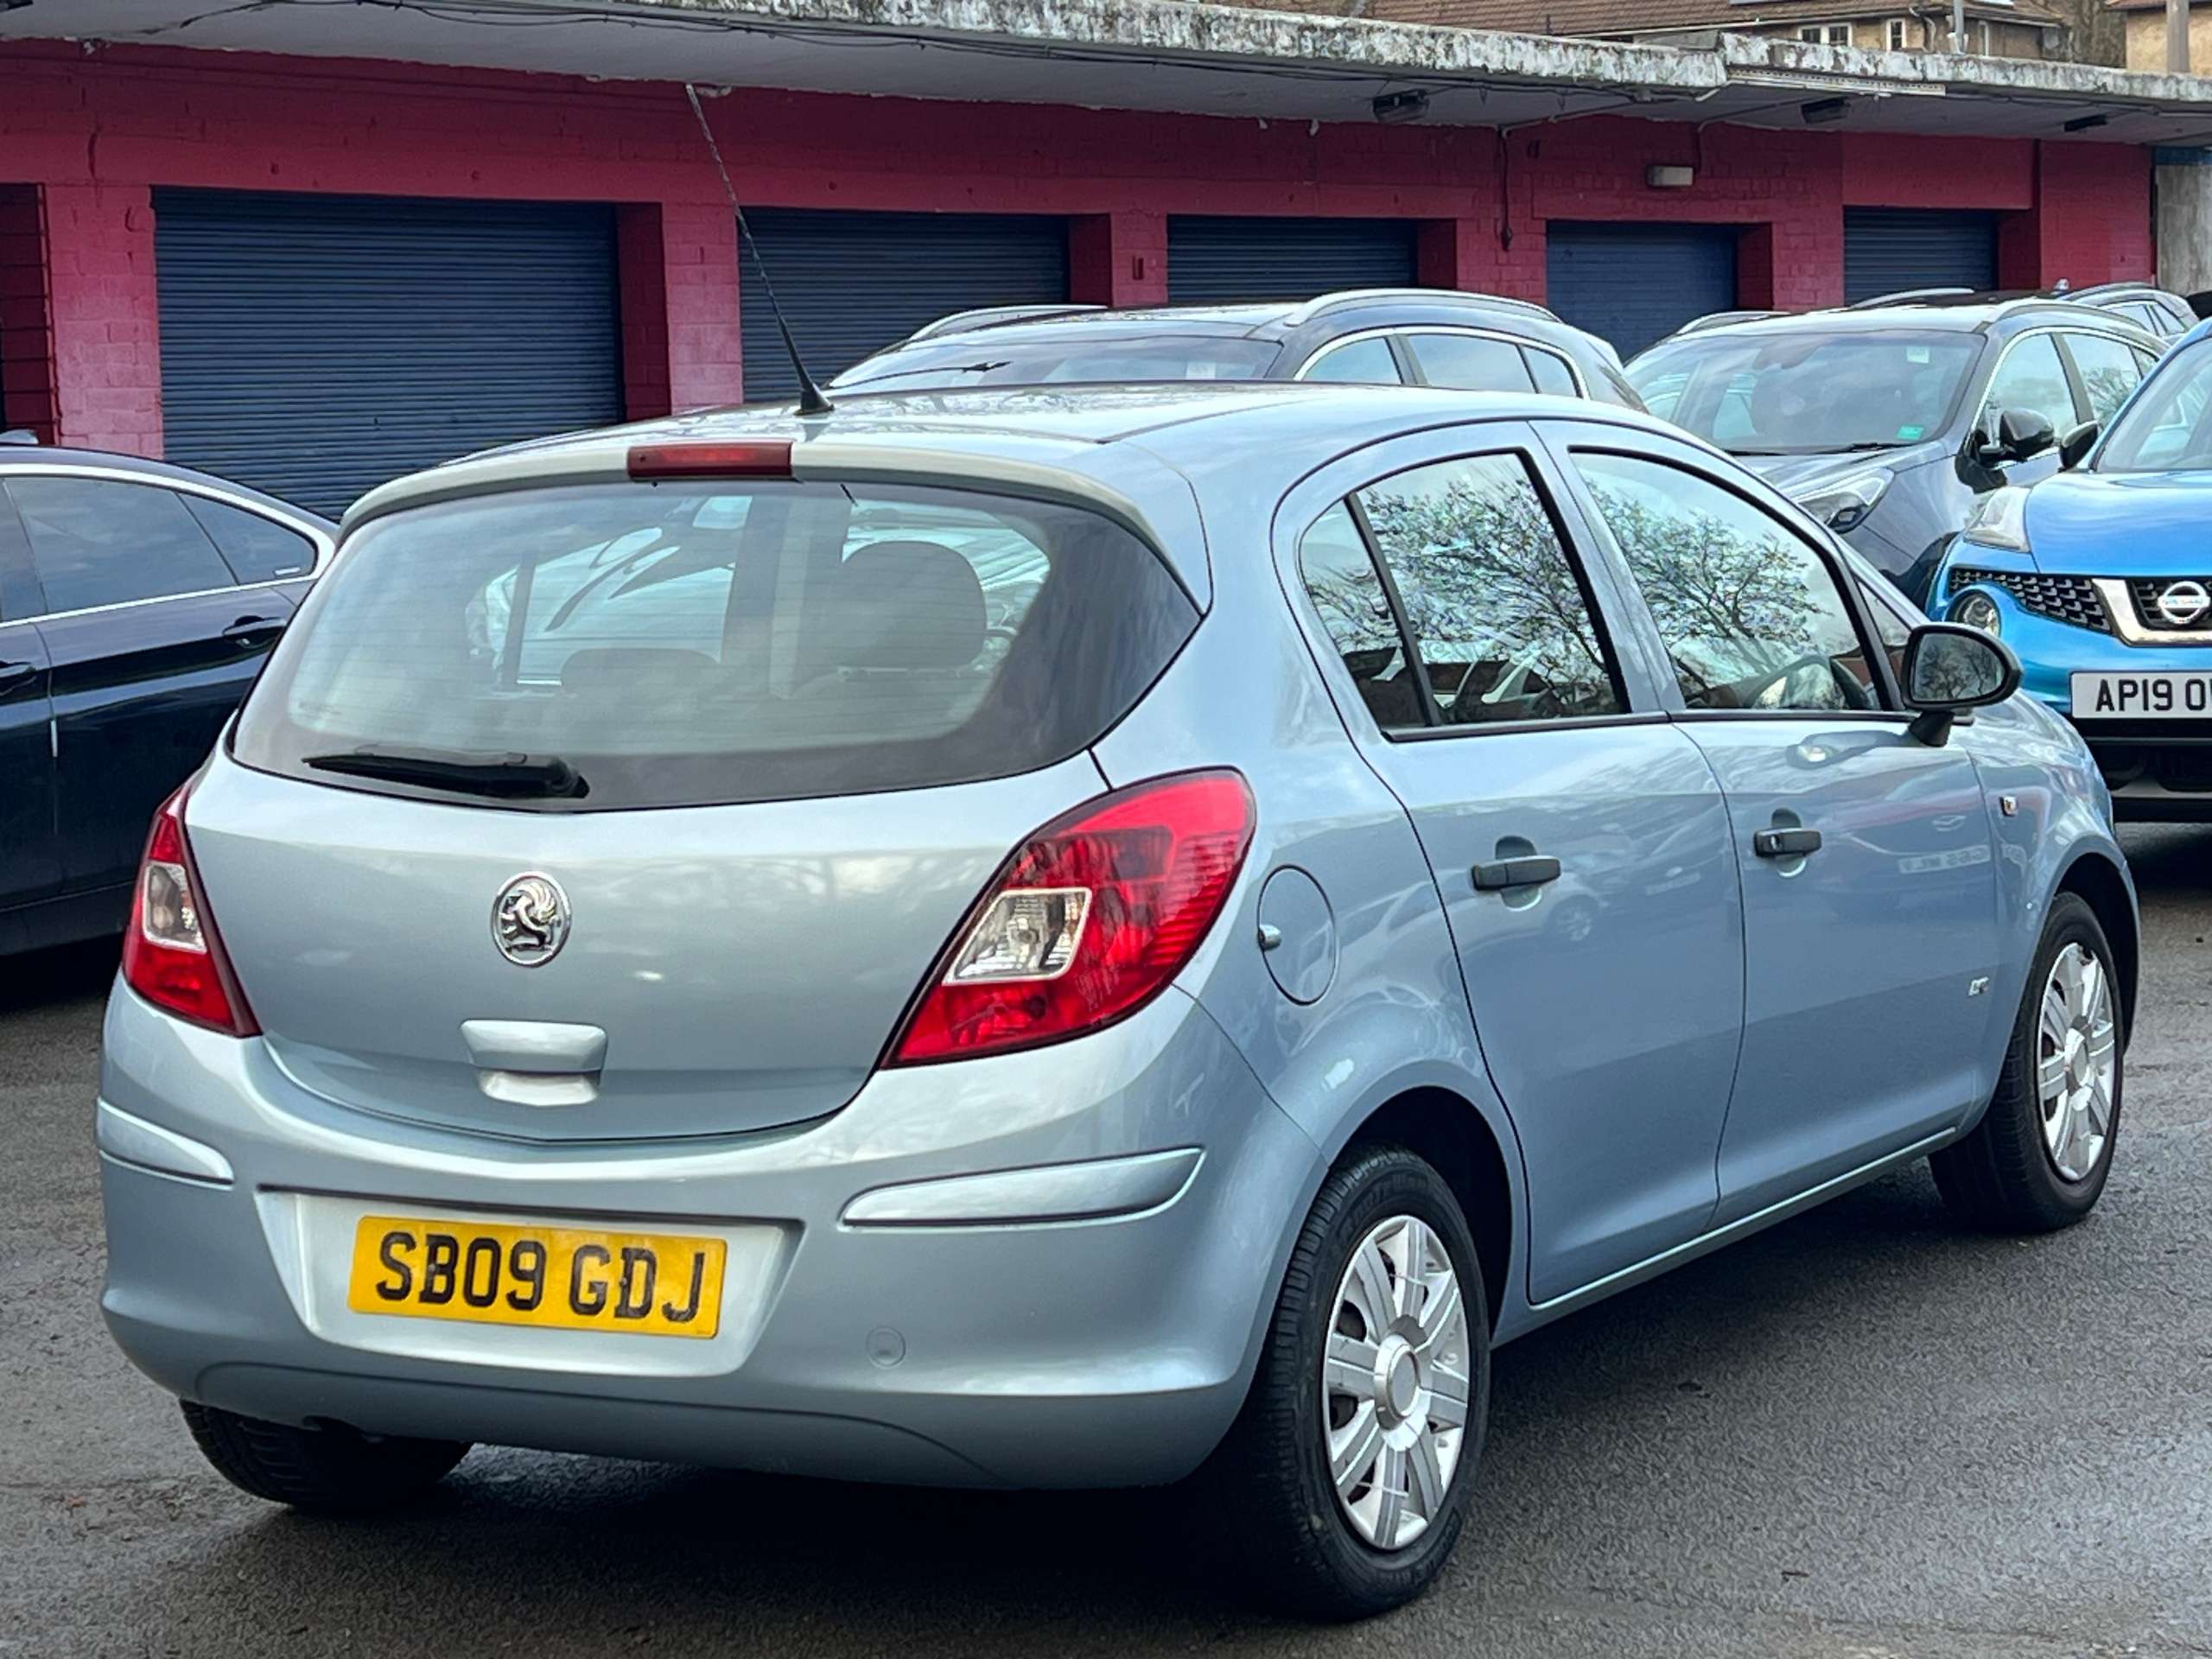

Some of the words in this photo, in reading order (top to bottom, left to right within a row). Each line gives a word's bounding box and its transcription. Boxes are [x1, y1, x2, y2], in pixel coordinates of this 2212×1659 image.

[2095, 678, 2172, 711] AP19
[2185, 678, 2212, 711] O
[376, 1231, 546, 1311] SB09
[568, 1244, 705, 1323] GDJ
